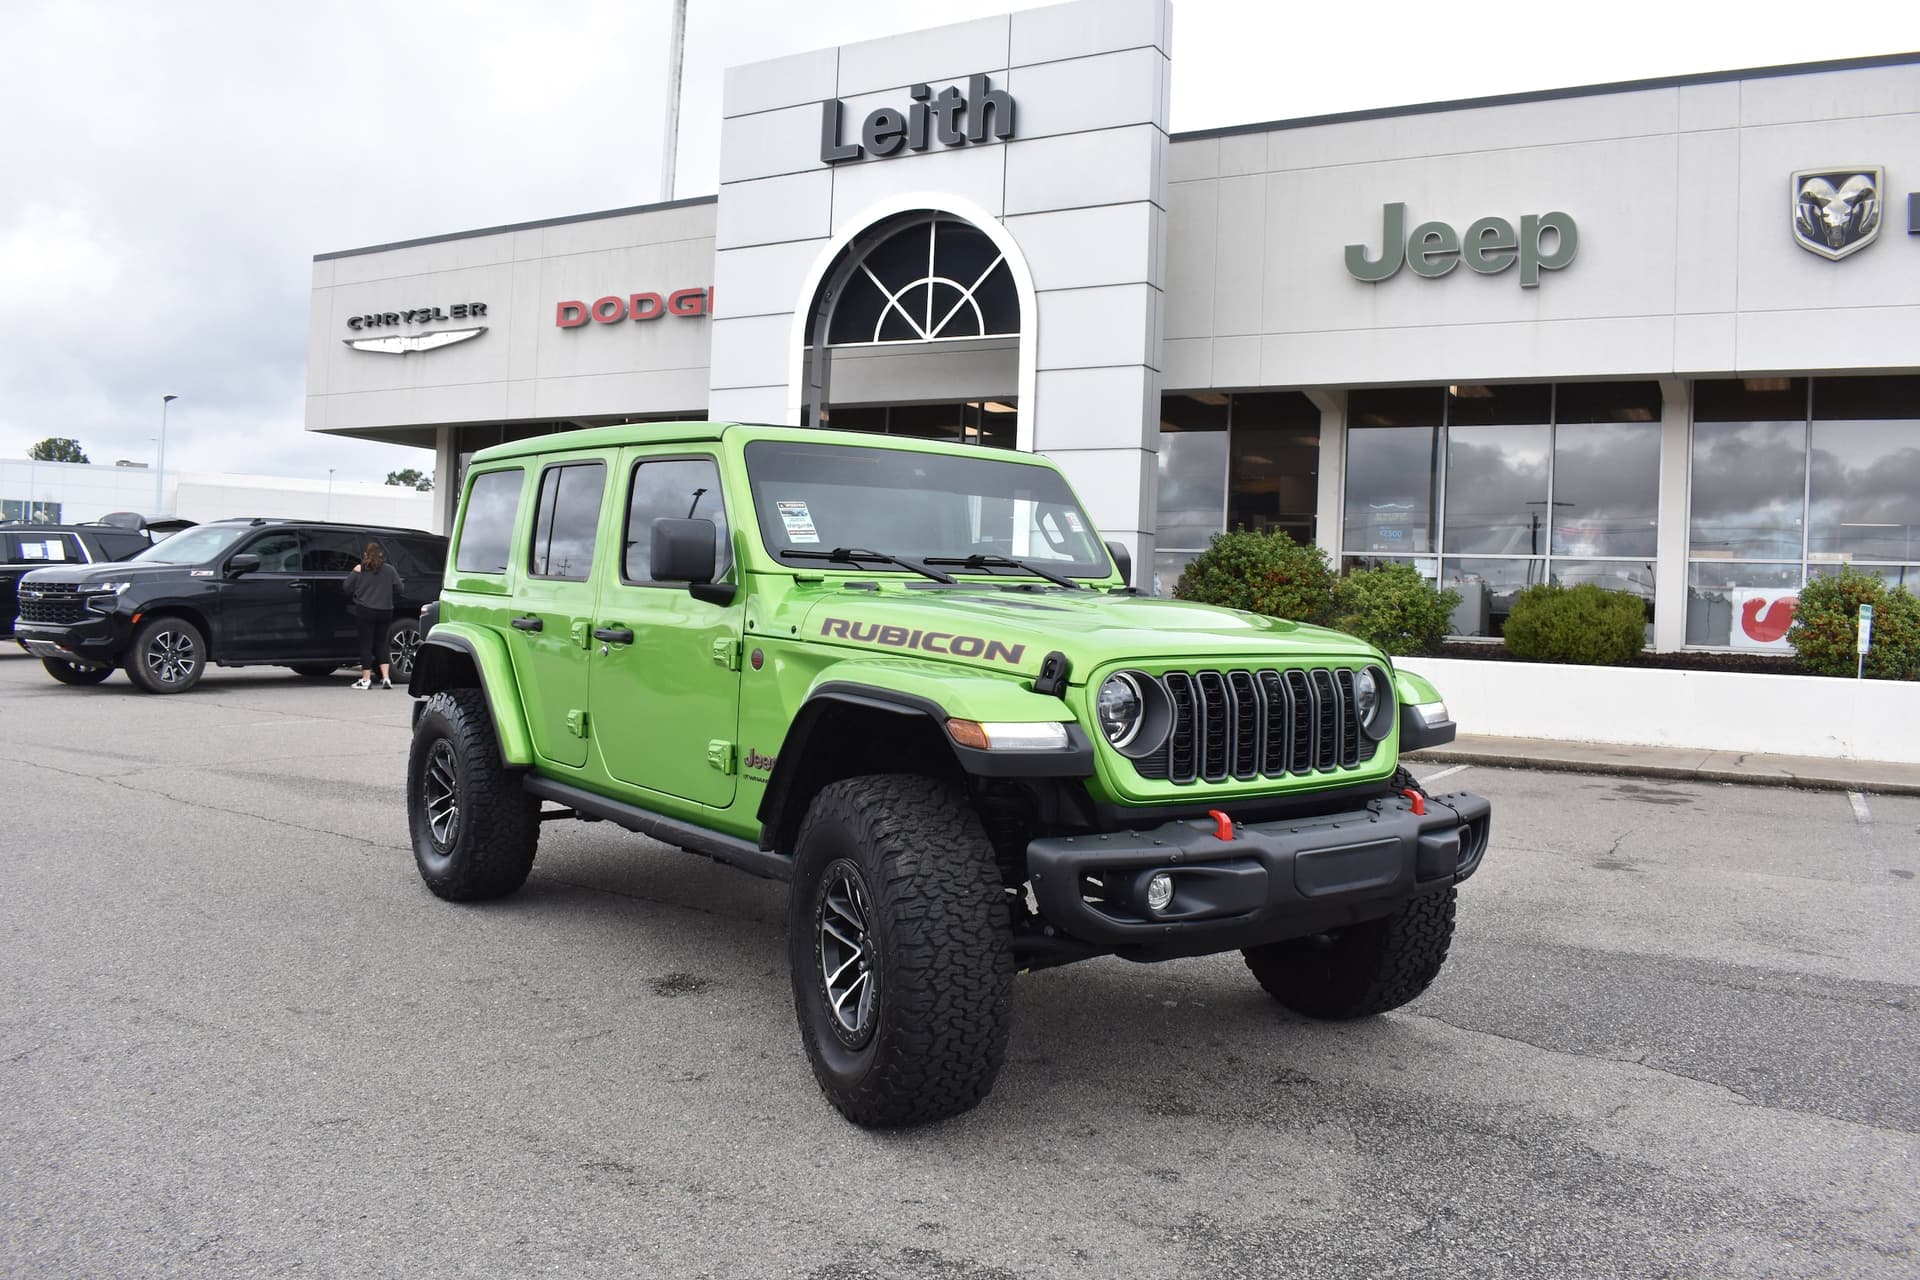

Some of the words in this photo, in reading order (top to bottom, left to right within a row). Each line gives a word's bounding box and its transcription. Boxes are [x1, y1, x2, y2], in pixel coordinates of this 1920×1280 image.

[821, 73, 1016, 164] Leith
[1344, 201, 1580, 288] Jeep
[347, 302, 487, 330] CHRYSLER
[556, 286, 714, 328] DODG
[820, 617, 1026, 665] RUBICON
